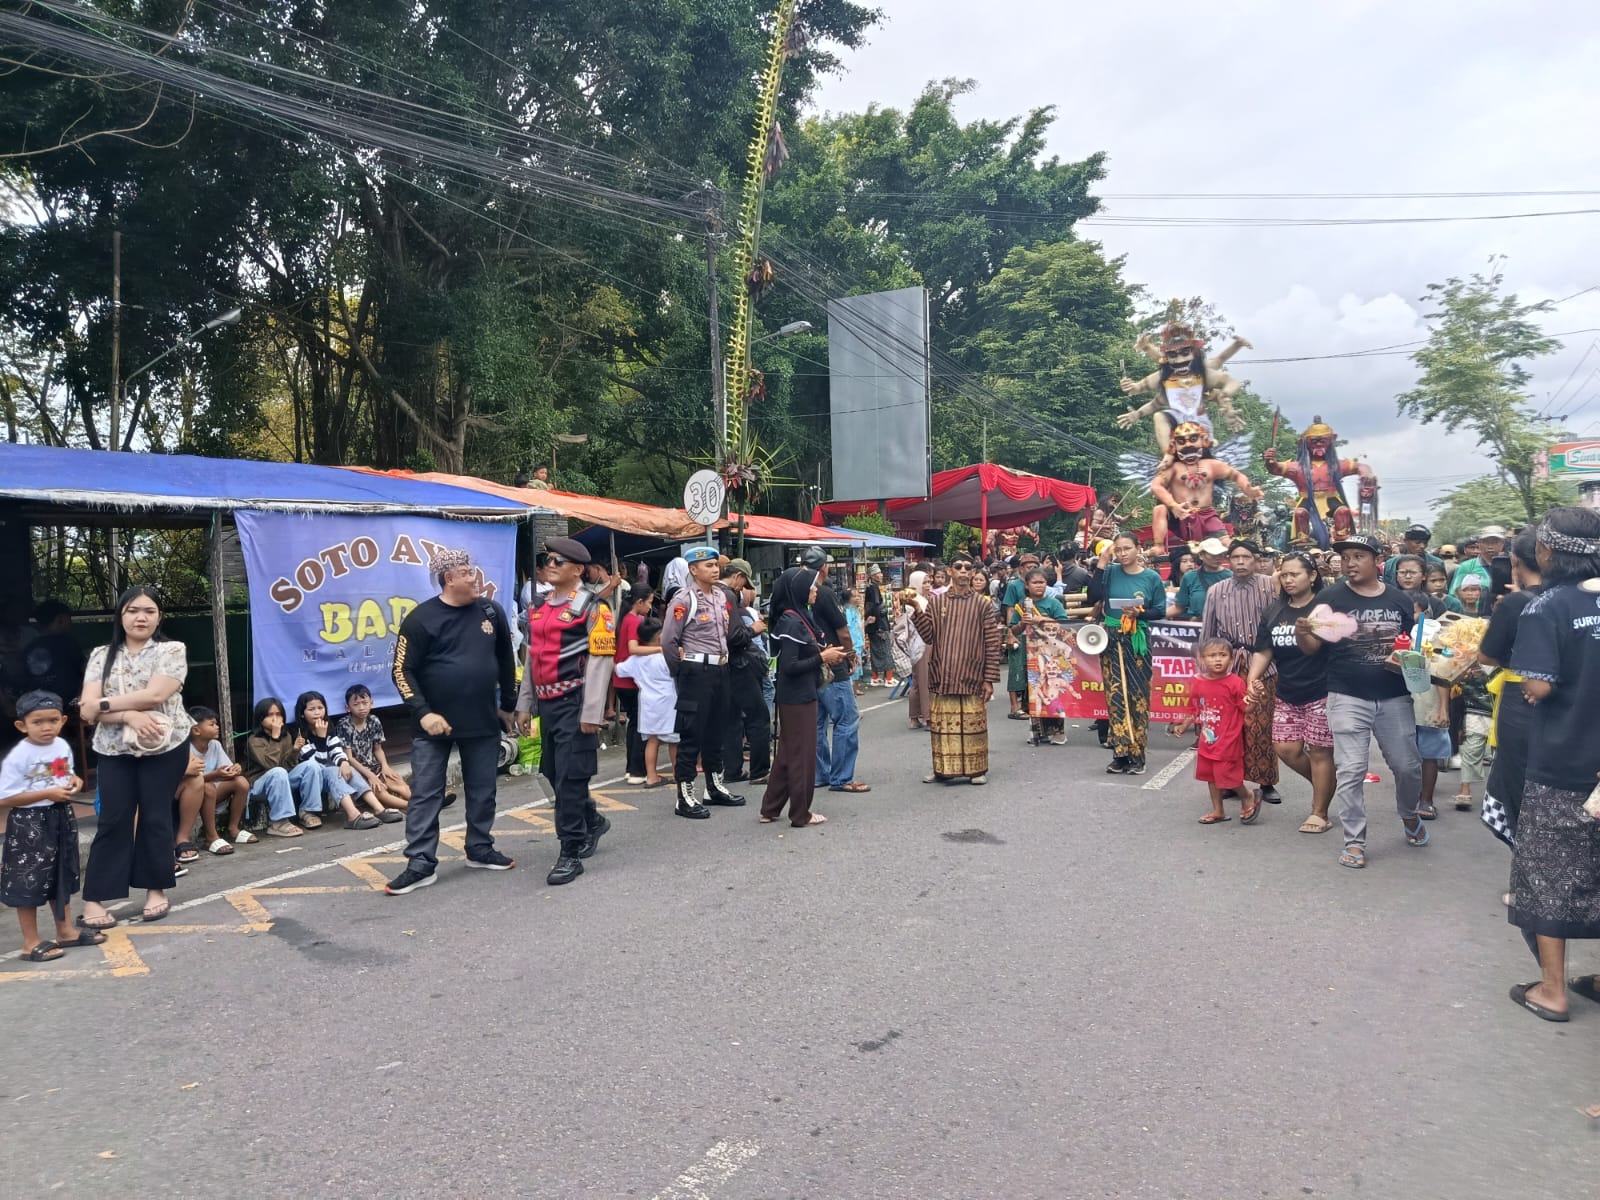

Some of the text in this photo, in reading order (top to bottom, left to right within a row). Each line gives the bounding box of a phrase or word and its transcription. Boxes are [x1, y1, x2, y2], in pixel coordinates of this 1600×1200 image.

[689, 480, 720, 514] 30
[269, 535, 498, 613] SOTO AYM
[1148, 627, 1197, 637] ACARA
[1164, 683, 1187, 694] AD
